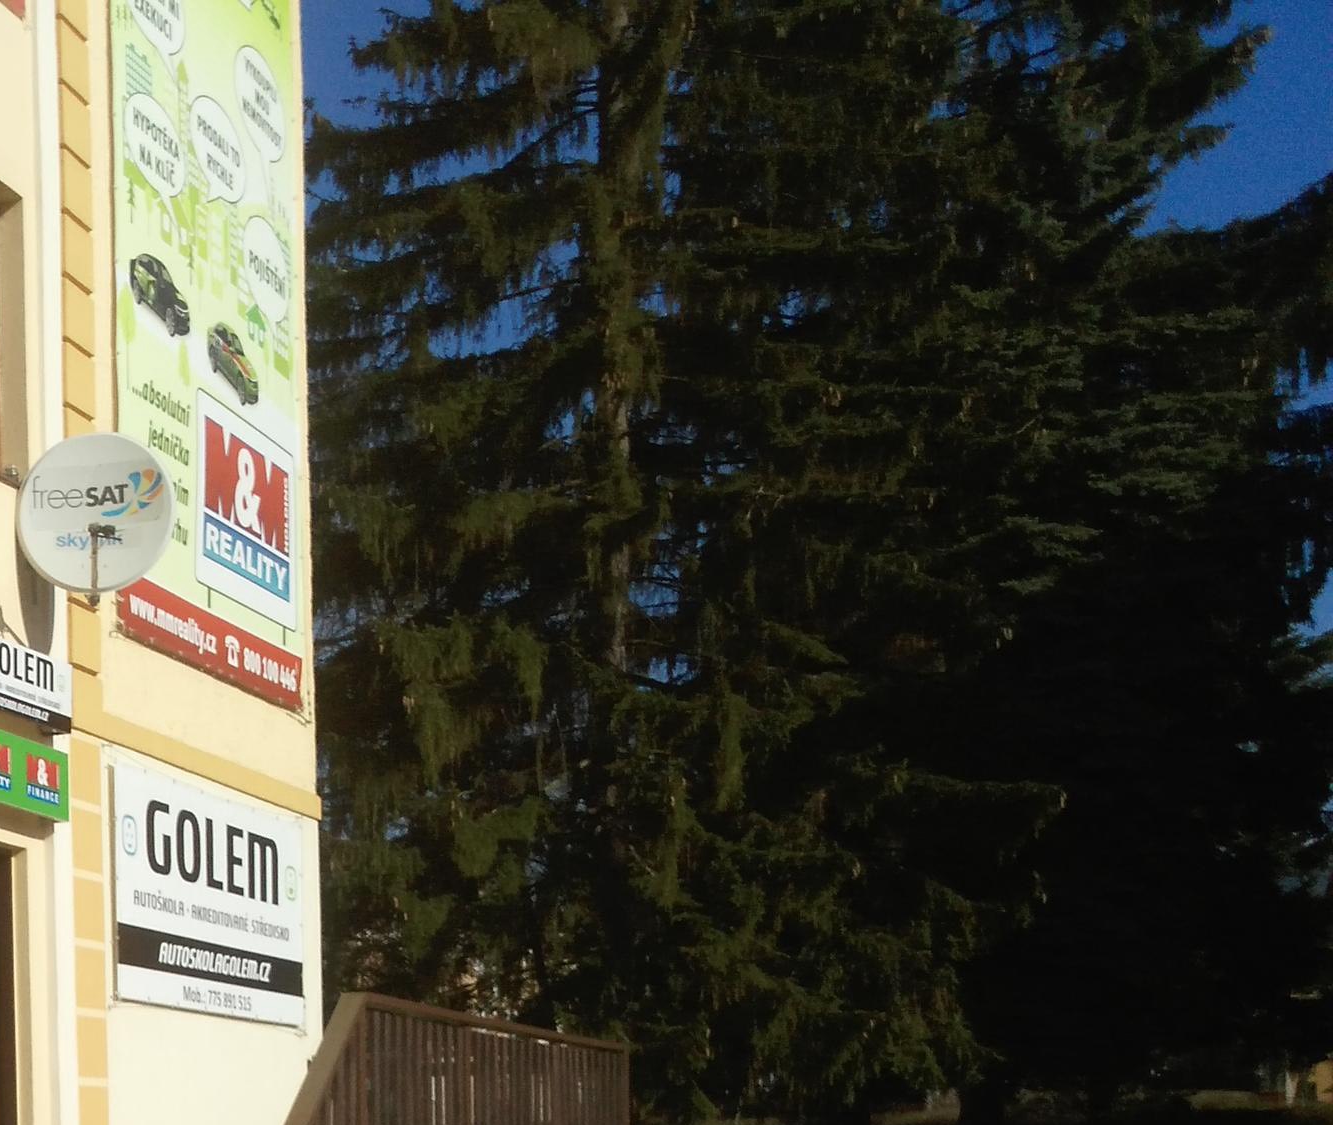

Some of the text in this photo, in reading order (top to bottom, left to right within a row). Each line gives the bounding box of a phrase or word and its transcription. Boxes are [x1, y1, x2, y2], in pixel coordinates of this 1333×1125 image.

[132, 107, 179, 162] HYPOTÉKA
[139, 144, 152, 170] NA
[30, 476, 128, 509] freeSAT
[206, 521, 287, 591] REALITY
[129, 593, 217, 655] www.mmreality.cz
[146, 799, 279, 906] GOLEM
[133, 889, 290, 942] AUTOŠKOLA AKREDITOVANÉ STŘEDISKO
[158, 941, 272, 982] AUTOSKOLAGOLEM.CZ
[208, 990, 221, 1006] 775
